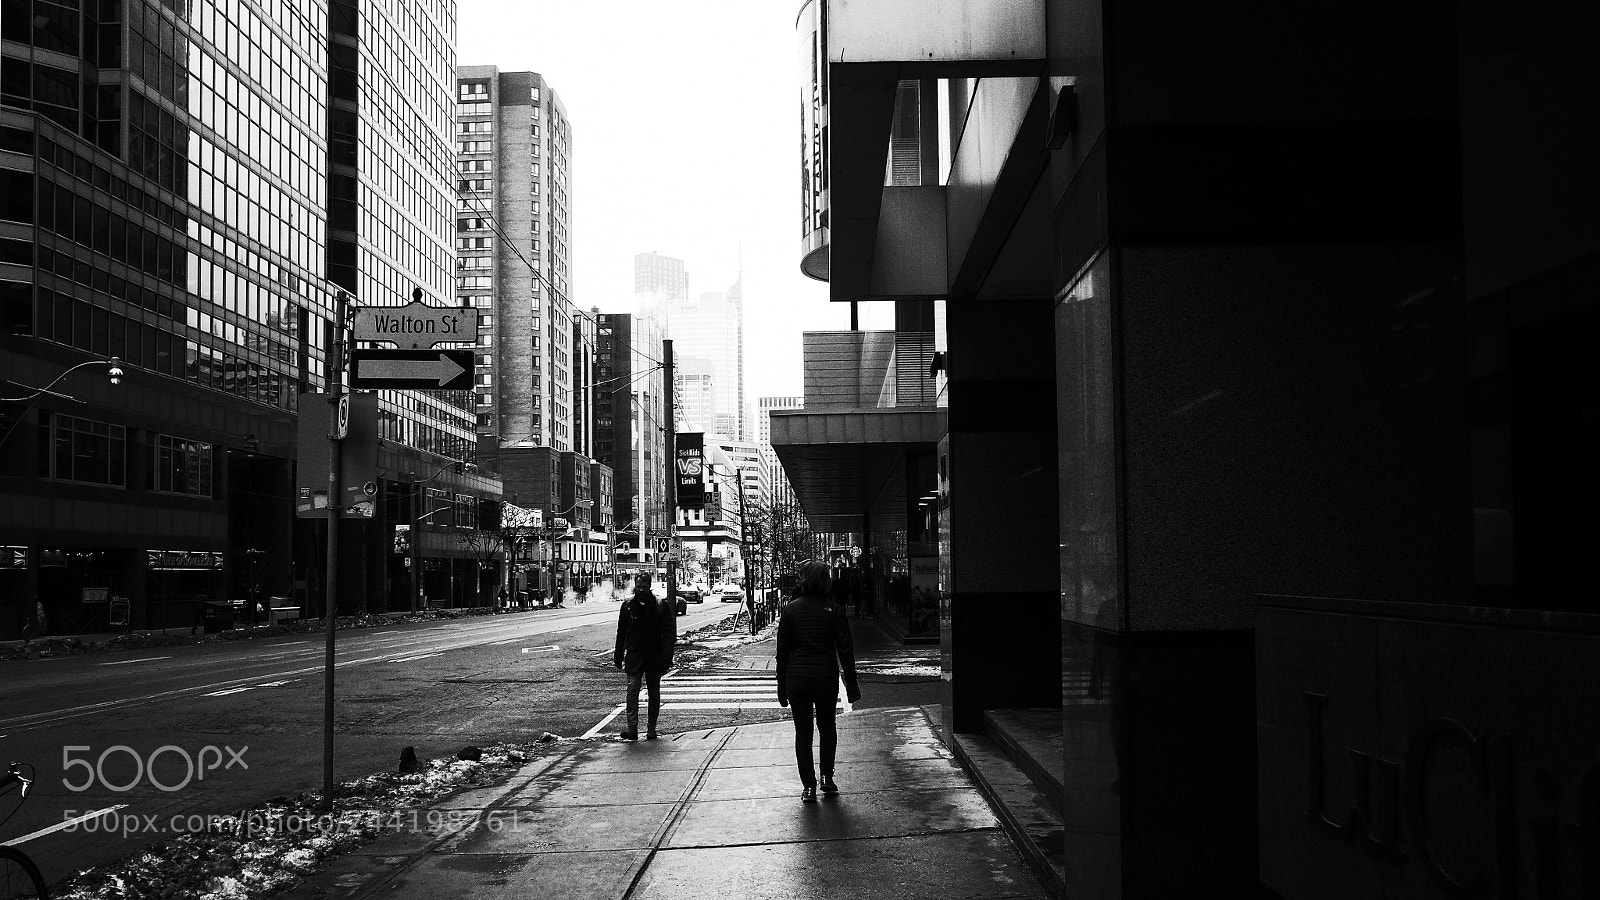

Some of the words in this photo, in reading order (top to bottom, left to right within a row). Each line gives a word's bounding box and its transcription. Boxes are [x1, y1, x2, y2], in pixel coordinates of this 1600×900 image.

[374, 314, 435, 334] Walton
[440, 314, 458, 334] St
[678, 458, 702, 475] VS
